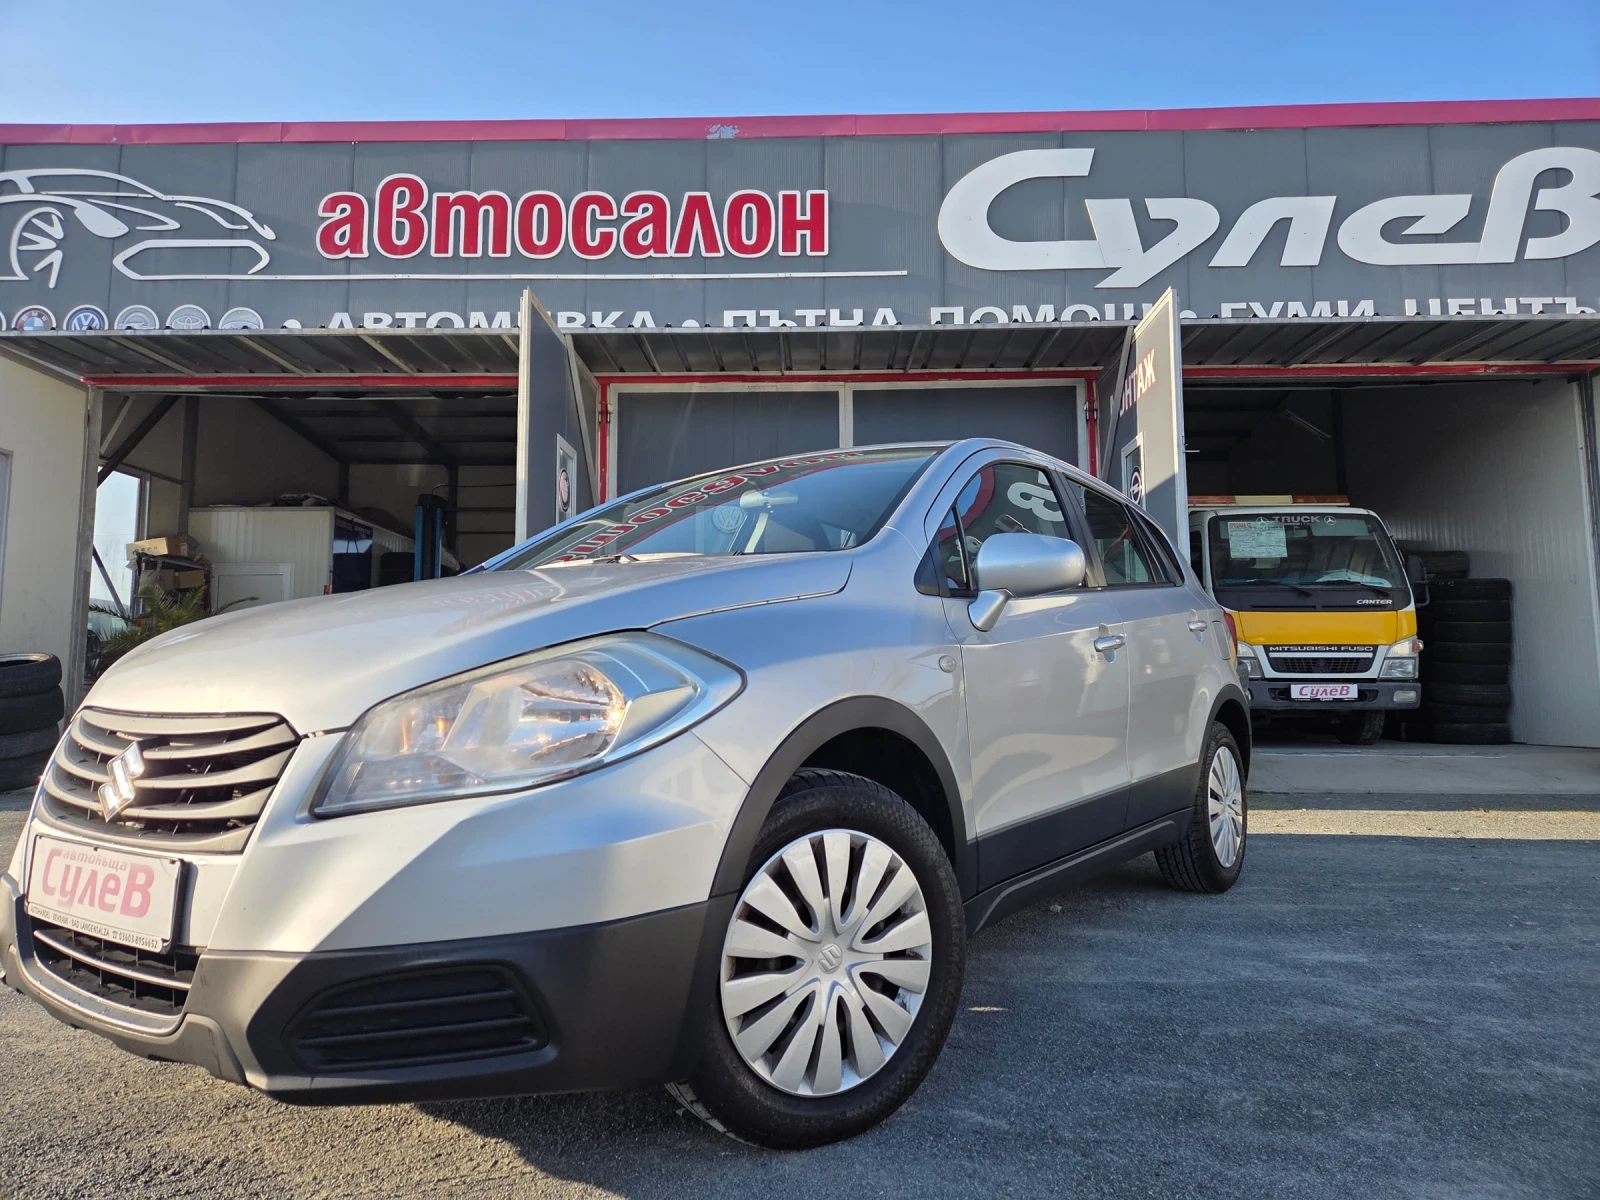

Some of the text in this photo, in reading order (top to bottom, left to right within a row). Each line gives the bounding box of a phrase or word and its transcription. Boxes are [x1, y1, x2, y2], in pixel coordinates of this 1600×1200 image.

[316, 172, 830, 260] автосалон
[327, 310, 657, 329] АВТОМВКА
[1271, 515, 1321, 523] TRUCK
